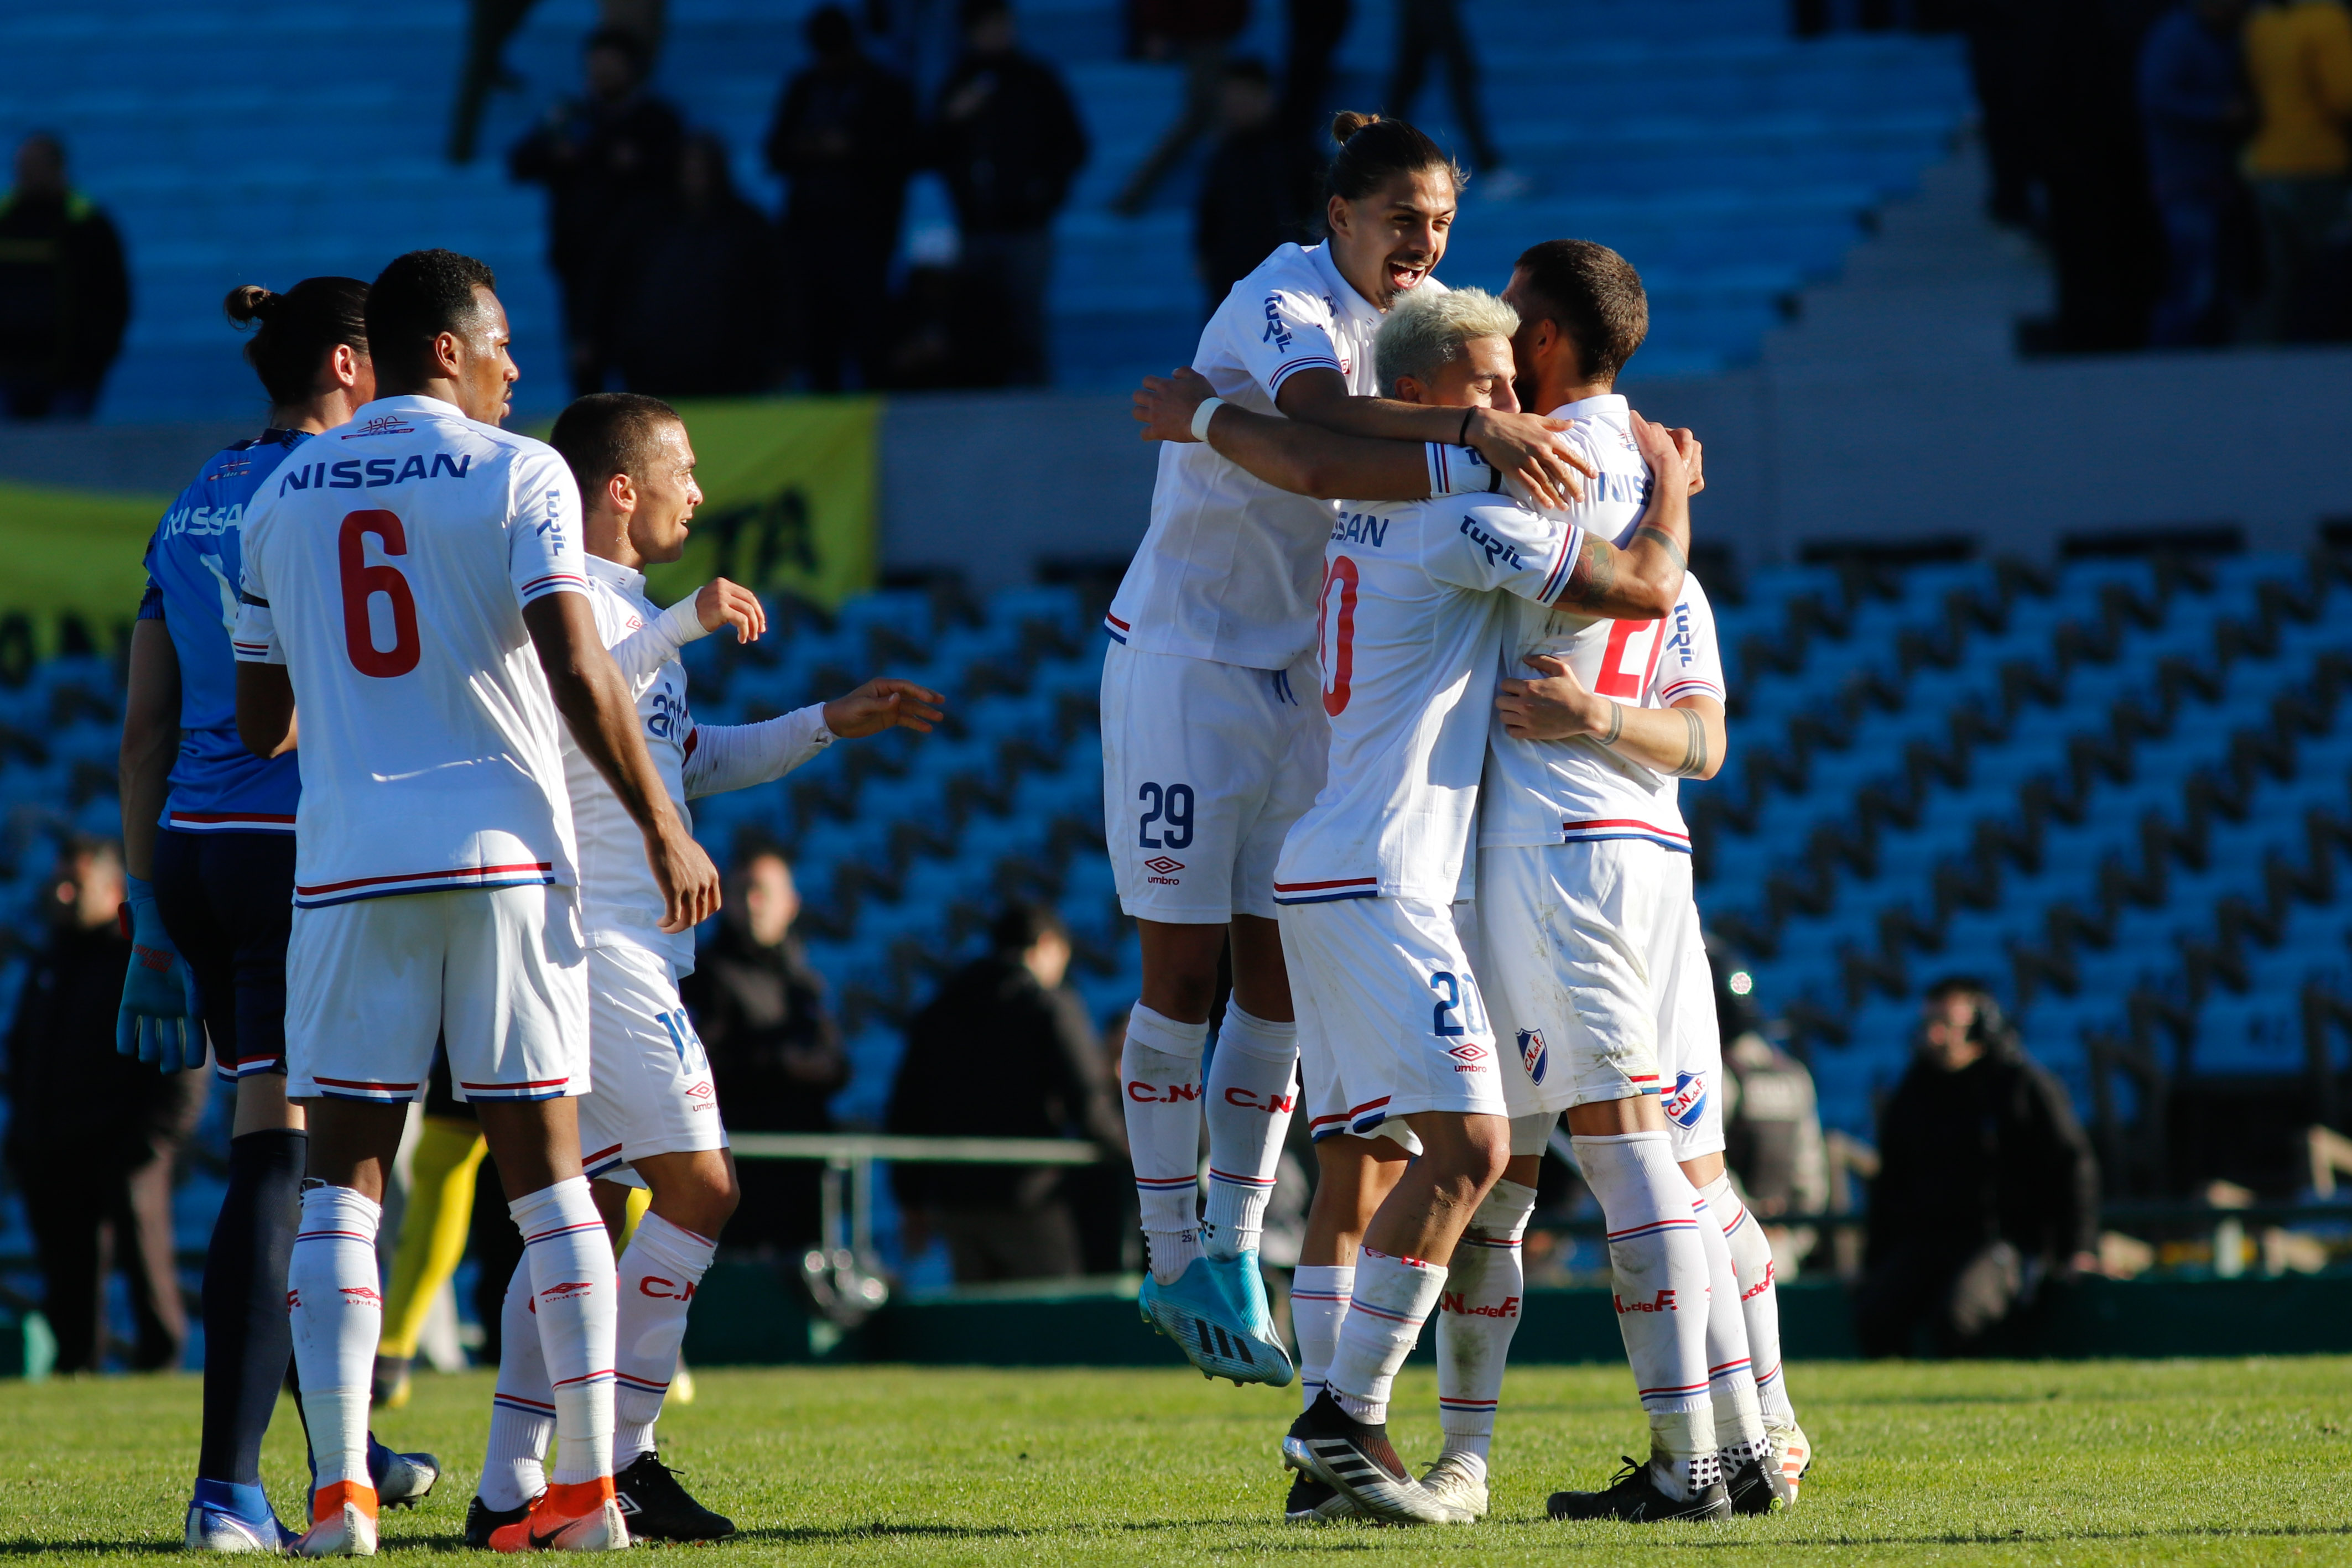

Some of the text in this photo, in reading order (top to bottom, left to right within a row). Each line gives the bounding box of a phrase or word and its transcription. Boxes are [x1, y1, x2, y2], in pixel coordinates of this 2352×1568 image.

[279, 454, 471, 498] NISSAN
[163, 503, 242, 540] NISSA
[338, 509, 421, 678] 6
[1139, 782, 1195, 850] 29
[1147, 876, 1180, 885] umbro
[1430, 971, 1488, 1036] 20
[654, 1008, 708, 1076] 18
[1454, 1064, 1487, 1073] umbro
[1181, 1234, 1193, 1243] 29
